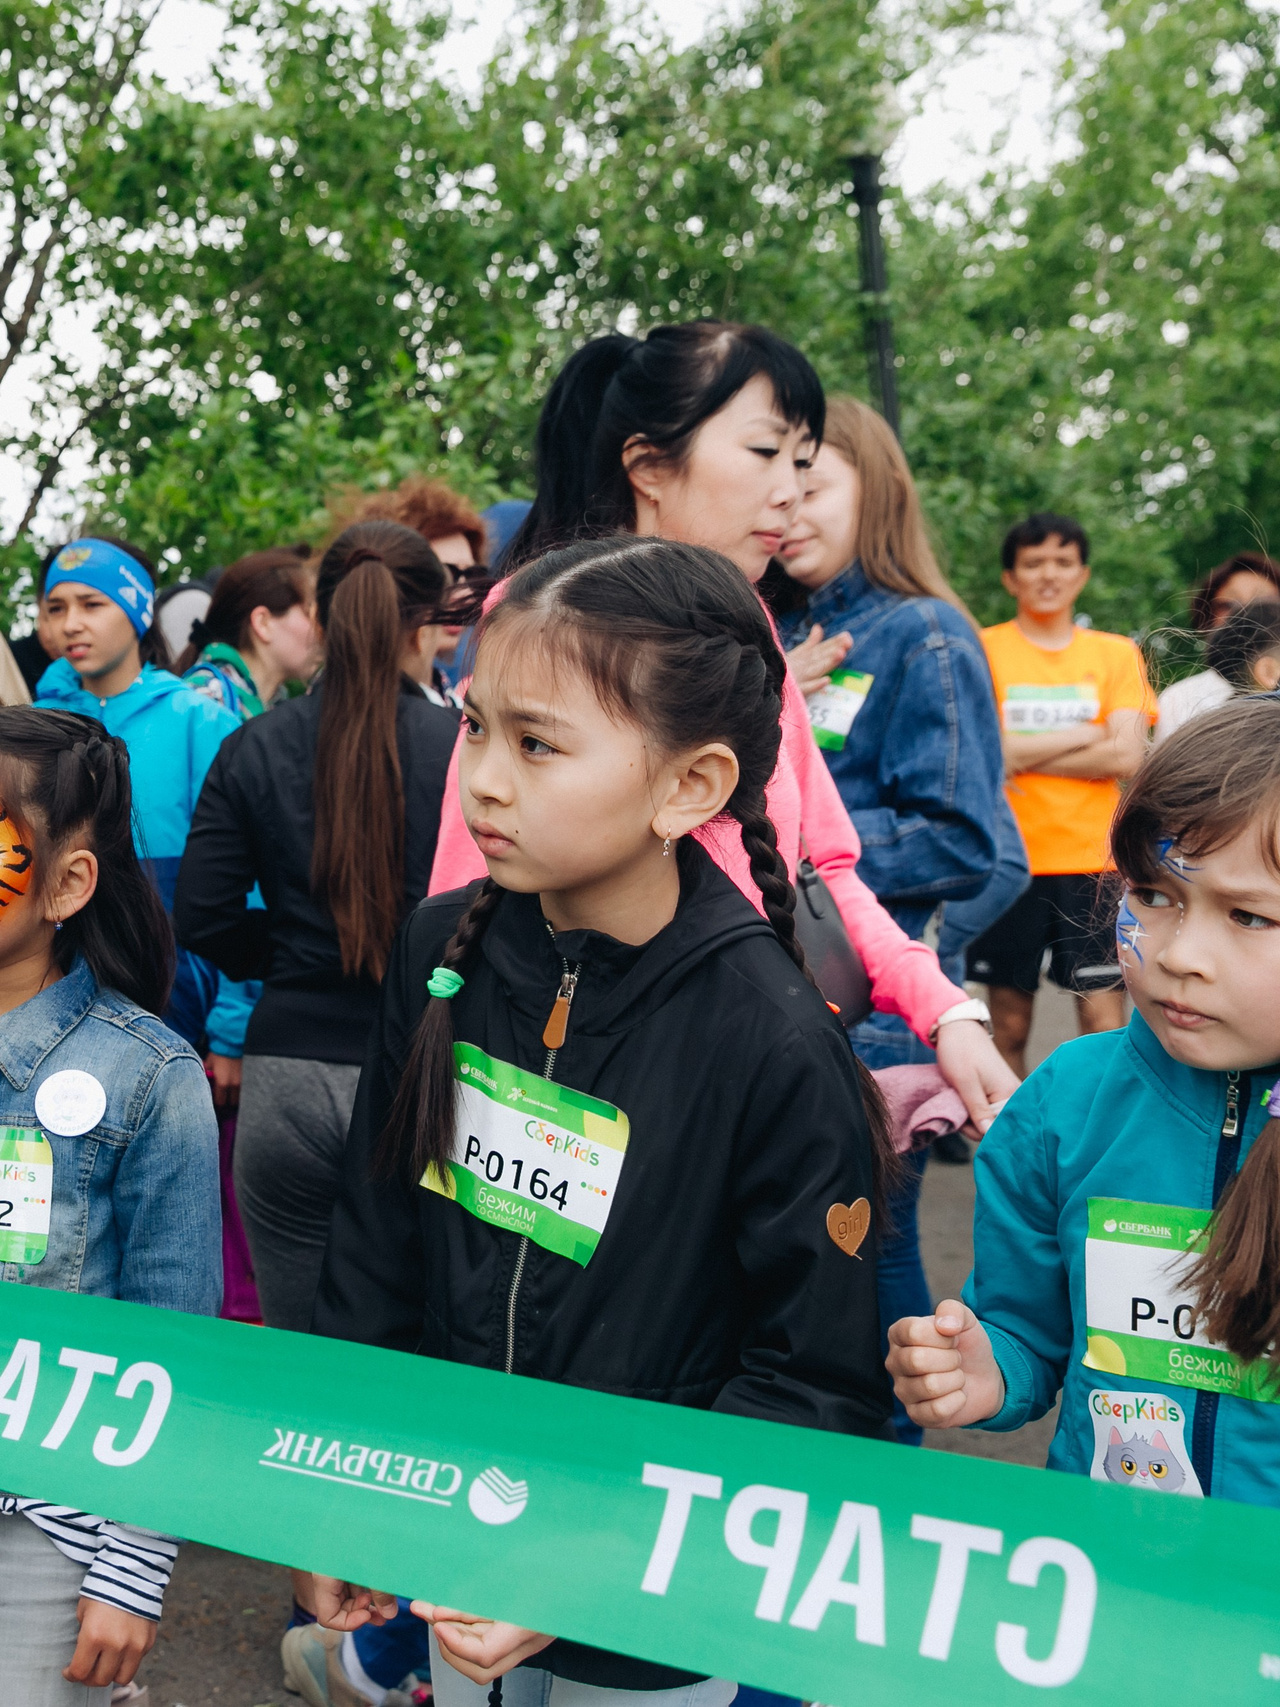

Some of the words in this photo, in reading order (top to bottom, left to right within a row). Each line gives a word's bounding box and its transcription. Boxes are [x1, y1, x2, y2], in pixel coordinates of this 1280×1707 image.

[525, 1120, 600, 1167] СберKids
[464, 1135, 569, 1211] P-0164
[477, 1187, 536, 1224] бежим
[838, 1212, 863, 1240] girl
[1118, 1221, 1172, 1237] СБЕРБАНК
[1169, 1349, 1241, 1380] бежим
[1093, 1394, 1180, 1424] СберKids
